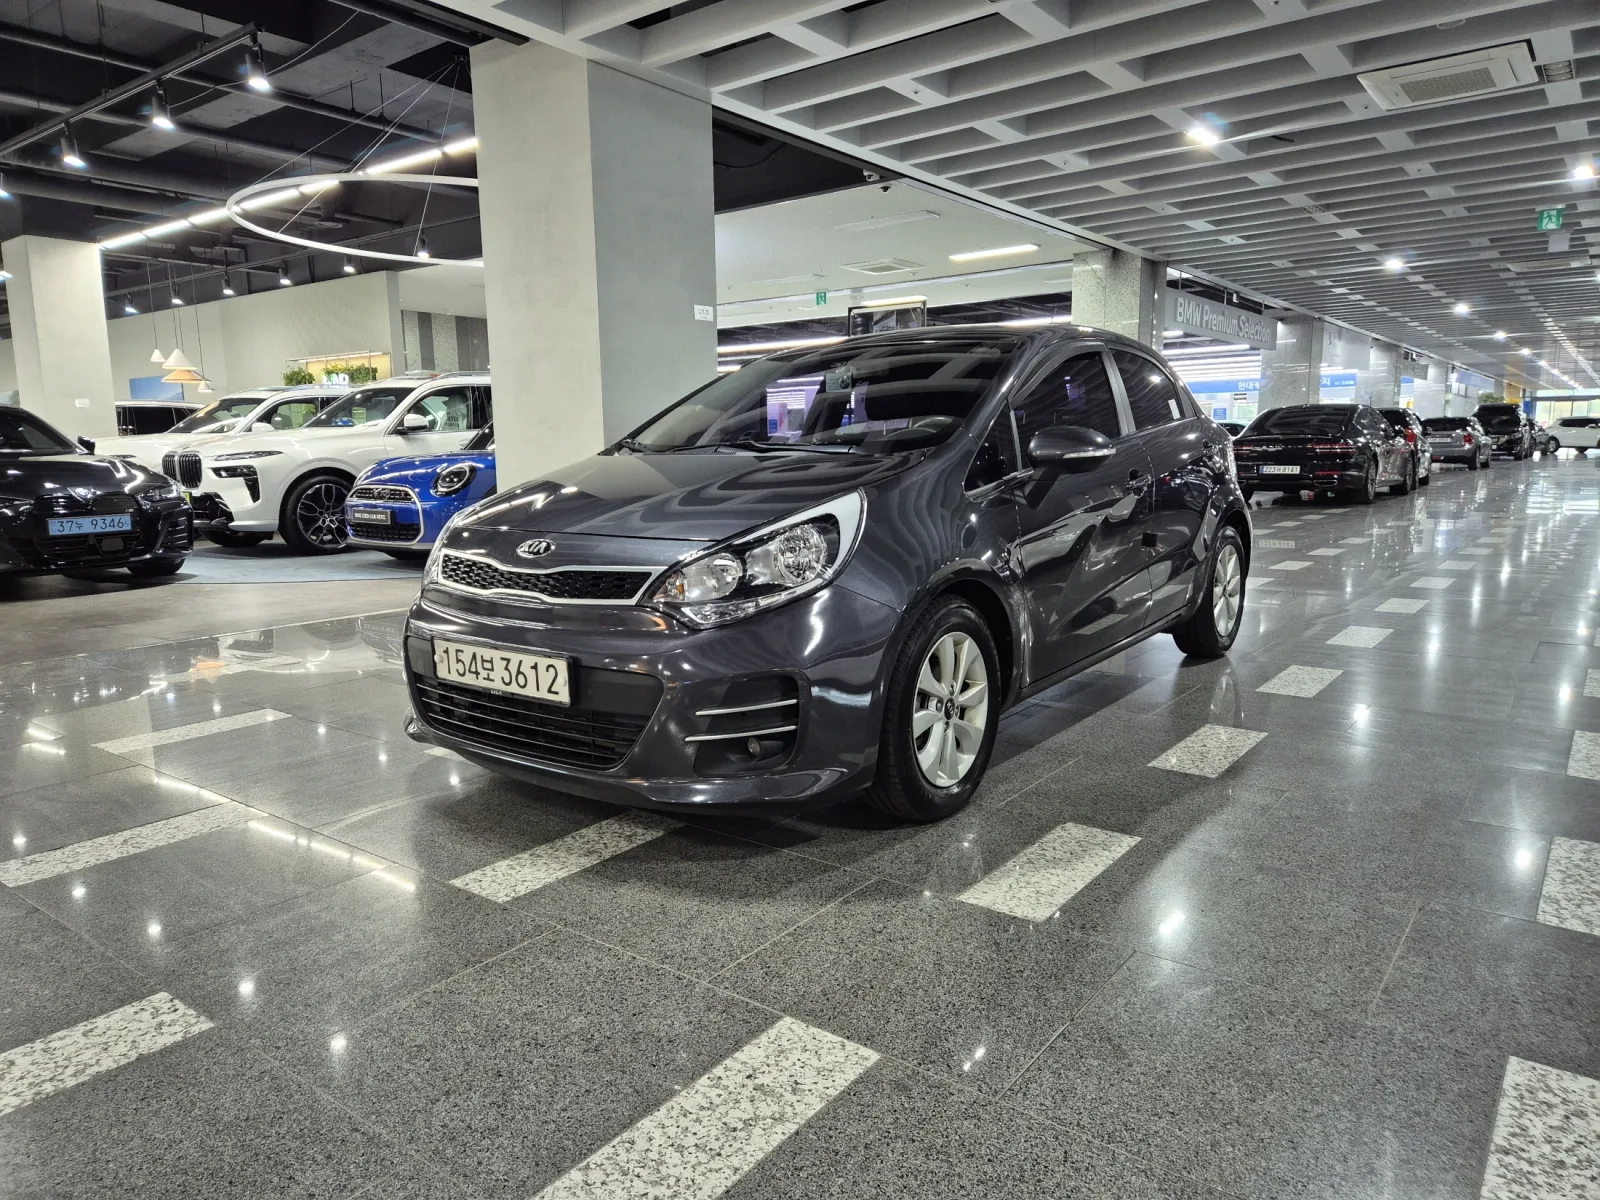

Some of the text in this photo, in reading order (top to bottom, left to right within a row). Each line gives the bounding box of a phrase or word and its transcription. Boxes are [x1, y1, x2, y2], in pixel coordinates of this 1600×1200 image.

[1177, 297, 1270, 342] BMW Premium Selection
[57, 517, 124, 533] 37누 9346
[518, 539, 550, 555] KIA
[443, 646, 560, 695] 154보 3612
